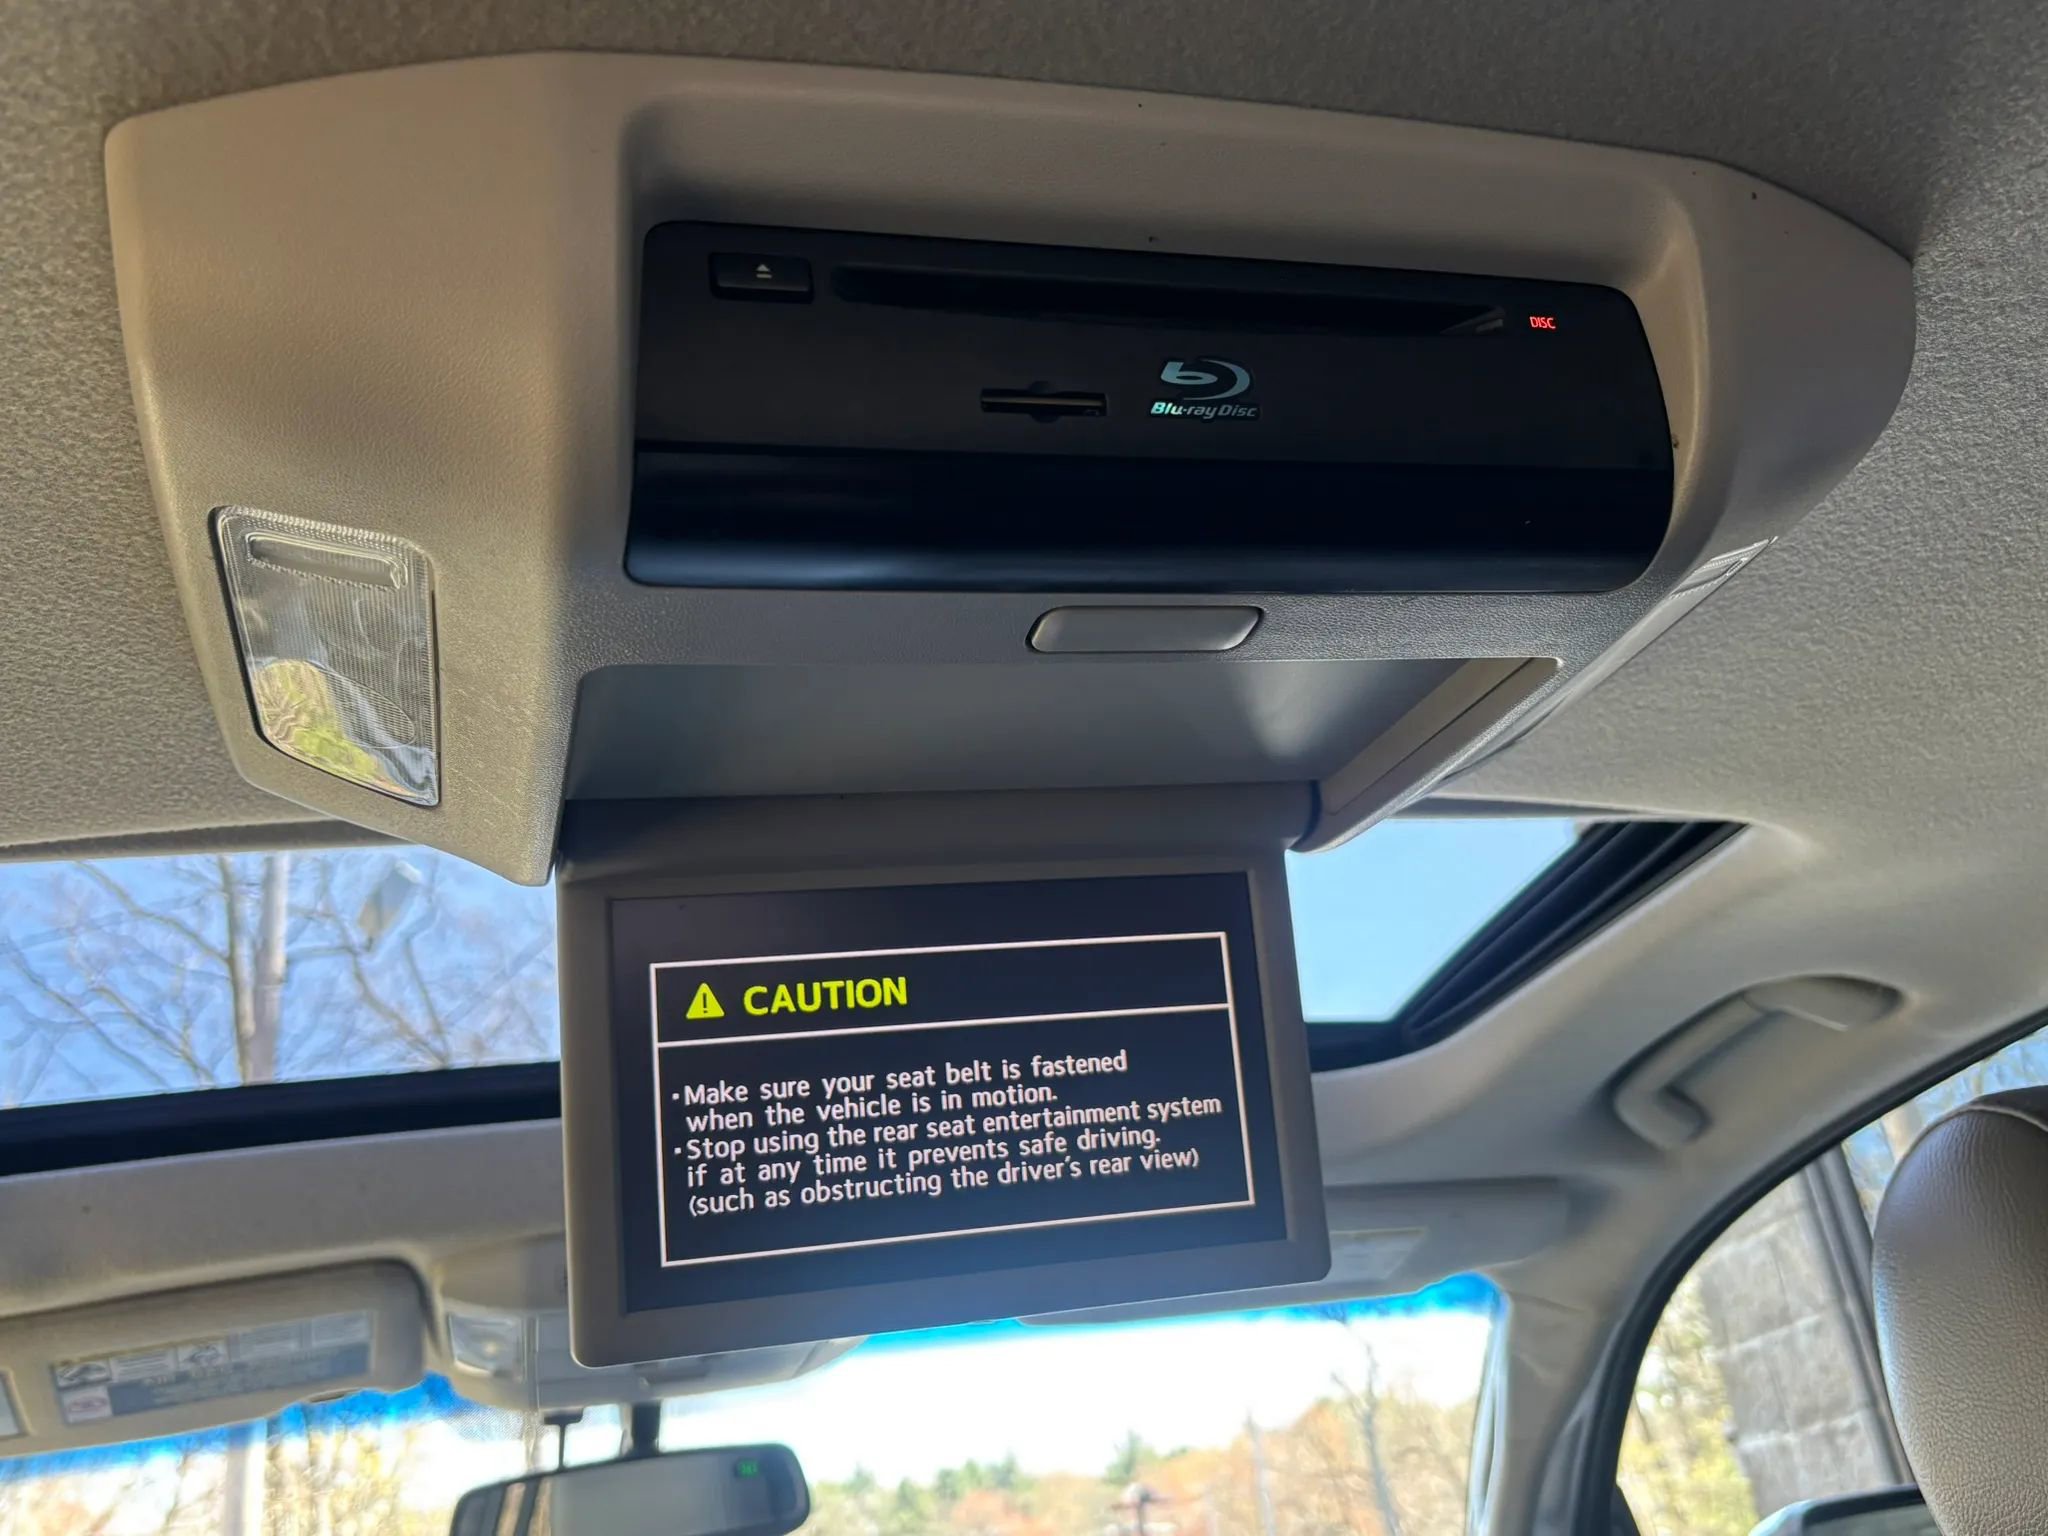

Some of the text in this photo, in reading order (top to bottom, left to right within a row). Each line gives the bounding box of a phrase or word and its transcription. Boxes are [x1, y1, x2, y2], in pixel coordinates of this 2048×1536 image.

[1529, 316, 1556, 329] DISC
[1151, 401, 1257, 420] Blu-ray Disc
[743, 976, 908, 1017] CAUTION
[684, 1049, 1128, 1106] Make sure your seat belt is fastened
[686, 1083, 1057, 1132] when the vehicle is in motion.
[686, 1096, 1222, 1161] Stop using the rear seat entertainment system
[687, 1126, 1161, 1187] if at any time it prevents safe driving.
[689, 1148, 1200, 1217] (such as obstructing the driver's rear view)
